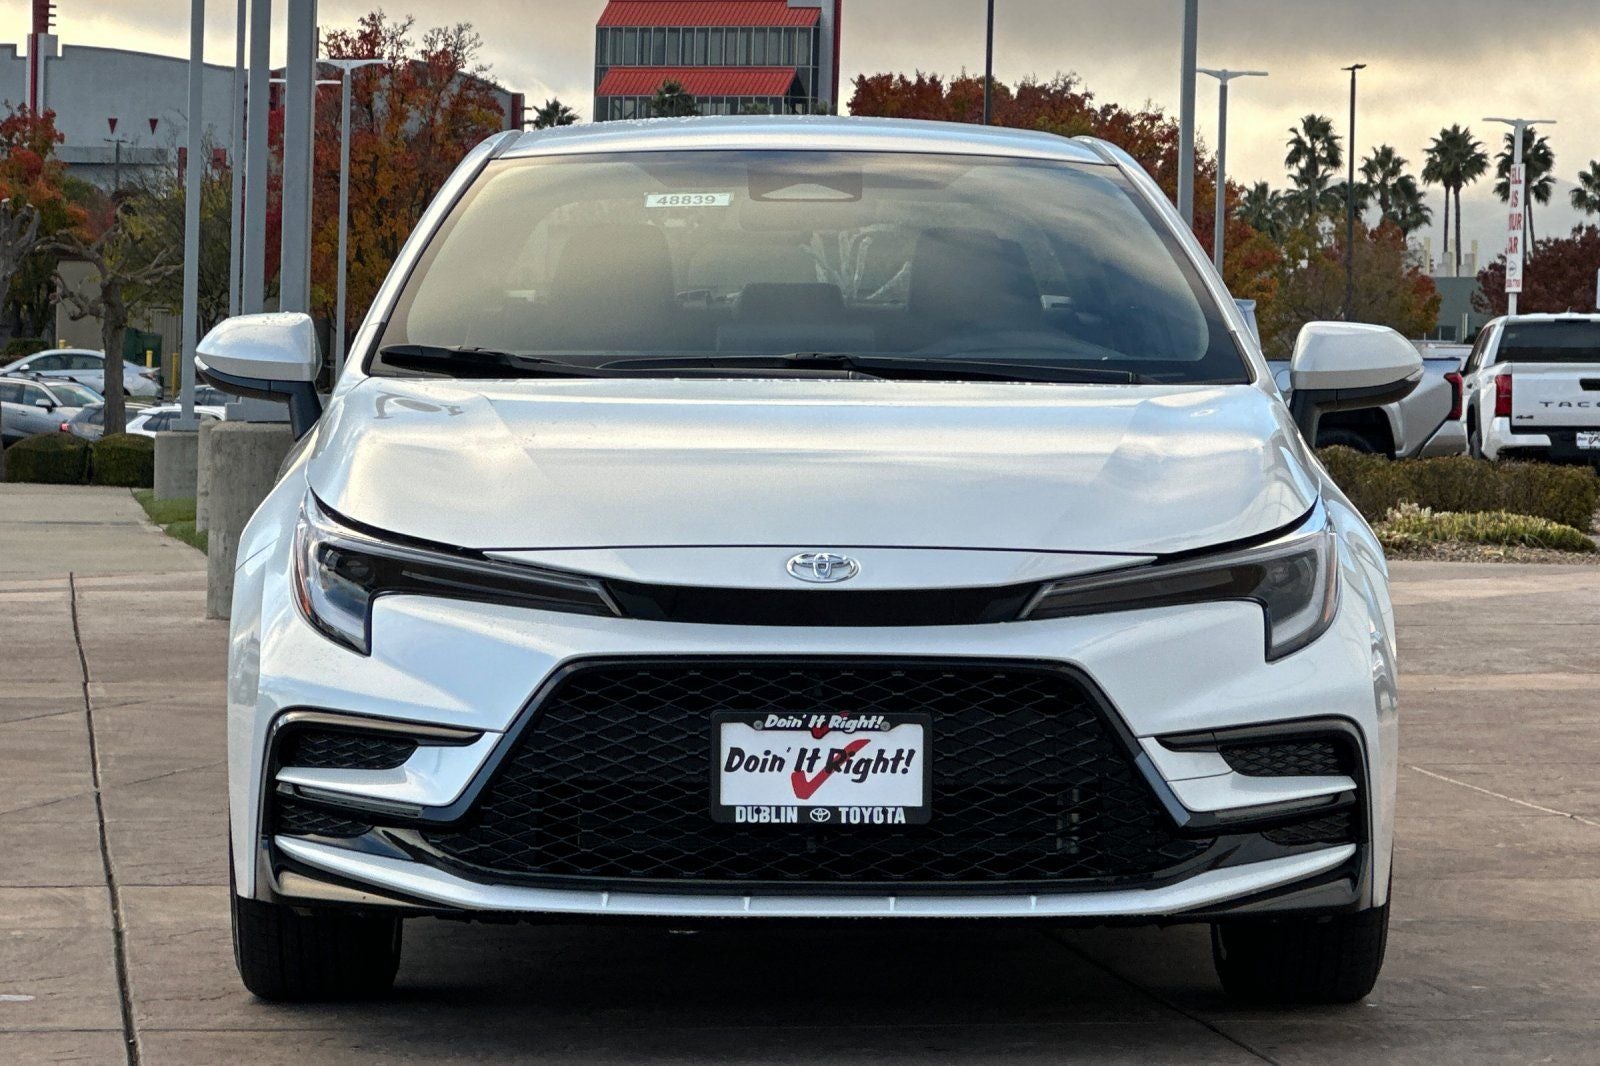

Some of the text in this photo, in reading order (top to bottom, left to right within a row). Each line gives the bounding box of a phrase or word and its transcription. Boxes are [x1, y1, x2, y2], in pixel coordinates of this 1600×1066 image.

[656, 195, 716, 205] 48839
[764, 714, 882, 733] Doin' It Right!
[723, 746, 916, 784] Doin' It Right!
[735, 806, 906, 824] DUBLIN TOYOTA
